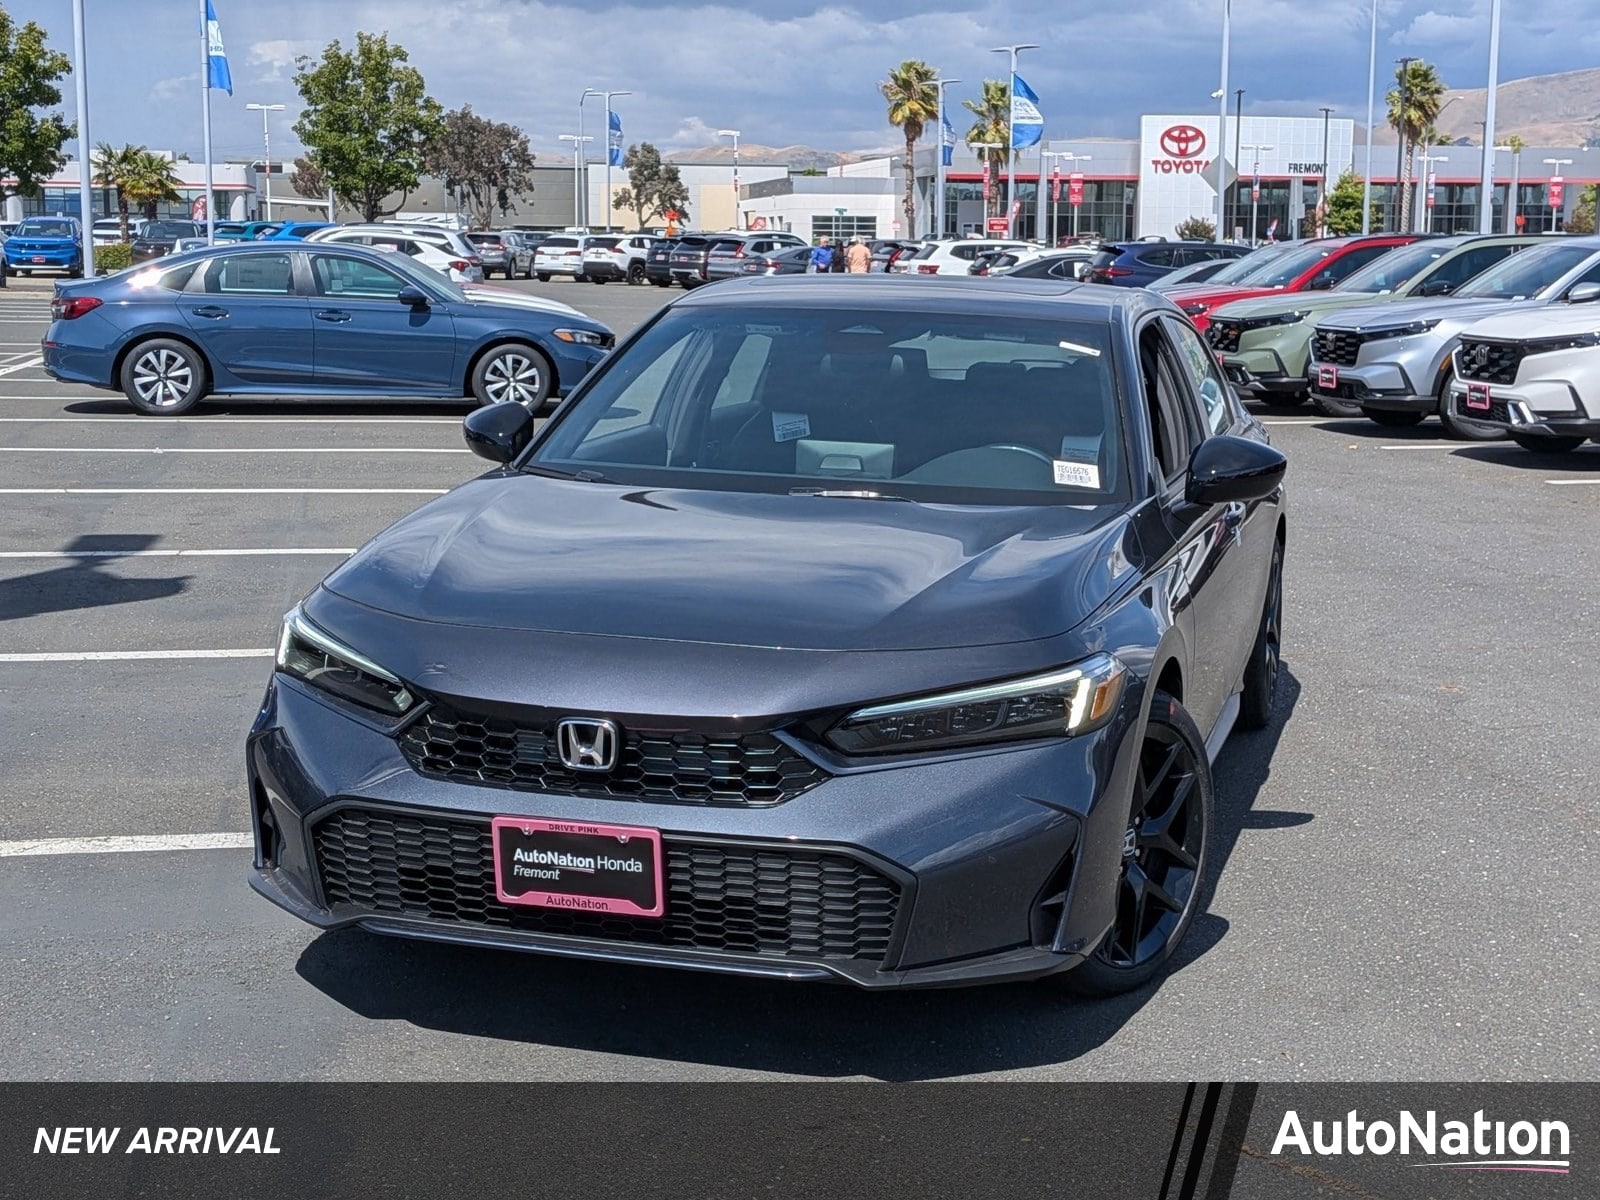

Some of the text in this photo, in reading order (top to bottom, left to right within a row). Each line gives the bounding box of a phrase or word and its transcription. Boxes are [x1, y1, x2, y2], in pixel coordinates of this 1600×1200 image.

[548, 823, 600, 835] DRIVE PINK
[513, 848, 642, 873] AutoNation Honda
[513, 865, 561, 880] Fremont
[546, 895, 609, 910] AutoNation
